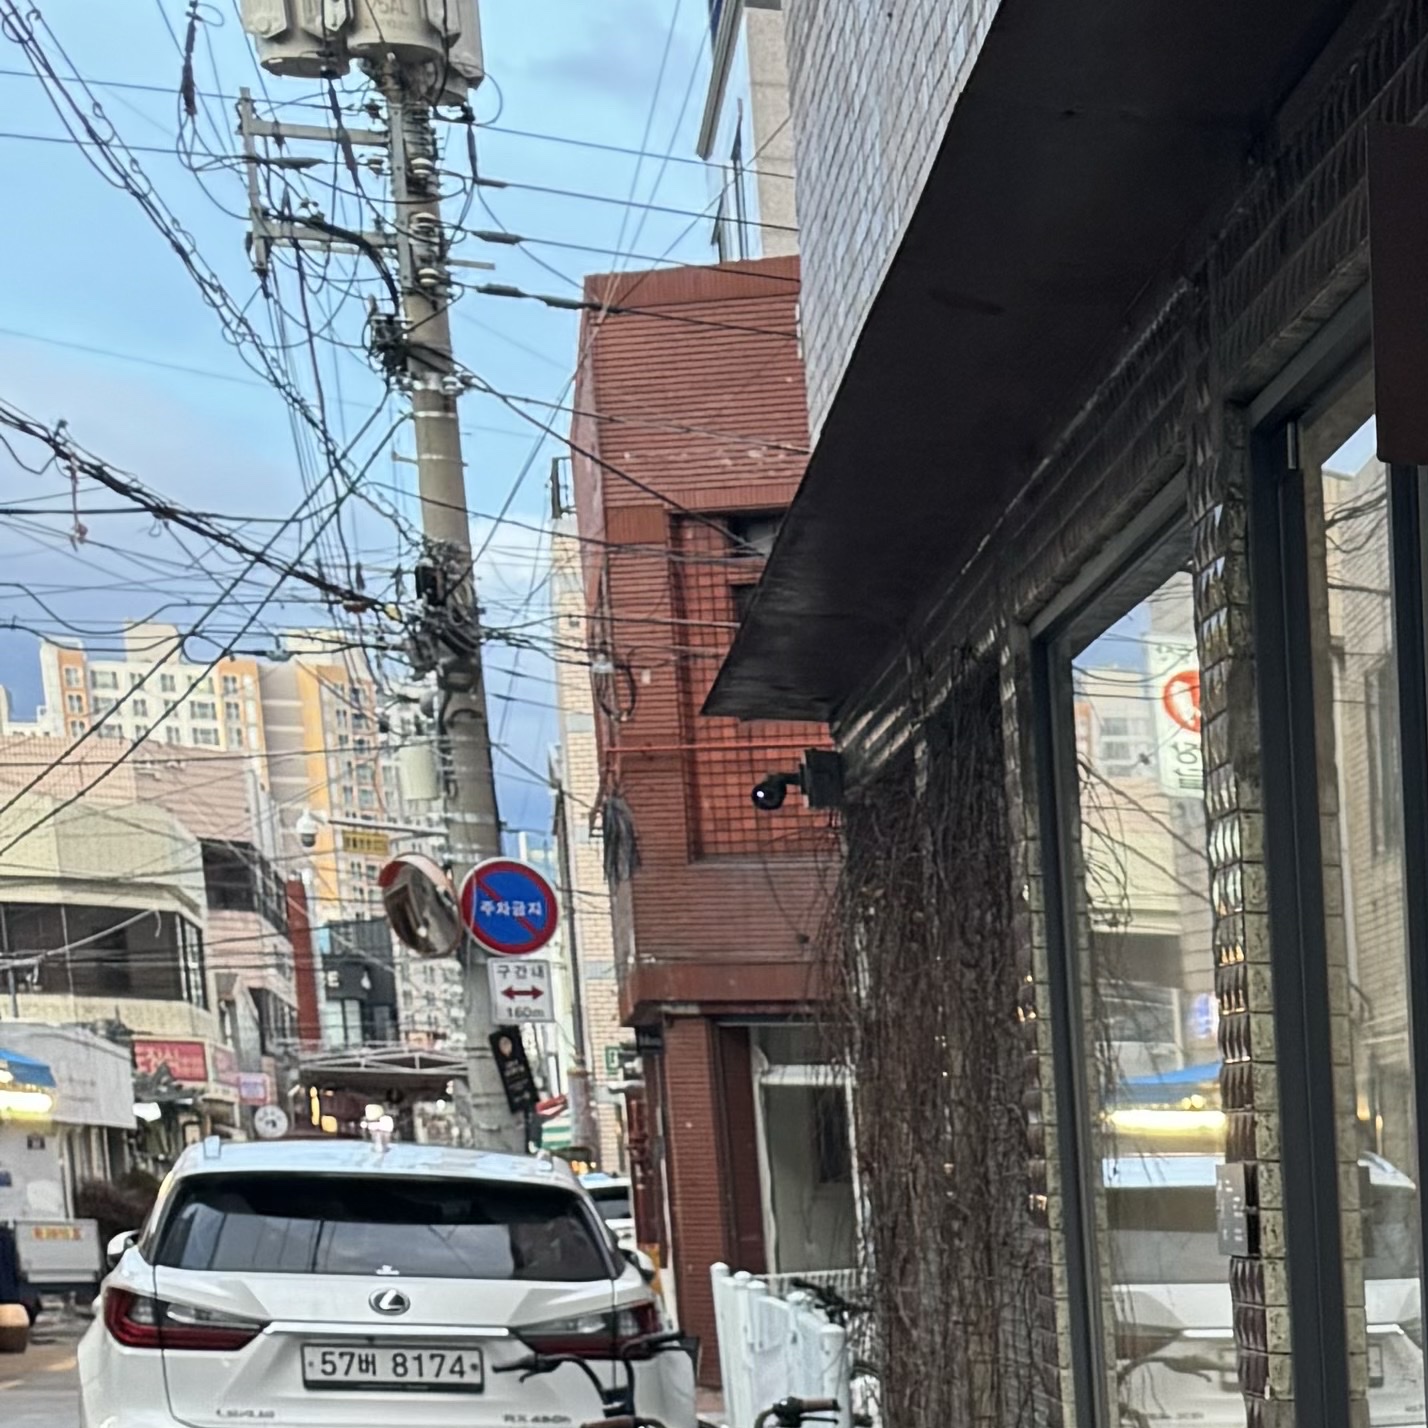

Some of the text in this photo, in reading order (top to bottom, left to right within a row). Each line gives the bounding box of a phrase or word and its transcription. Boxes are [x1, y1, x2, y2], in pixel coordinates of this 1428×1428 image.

[480, 900, 542, 917] 주차금지
[320, 1351, 467, 1378] 57버 8174
